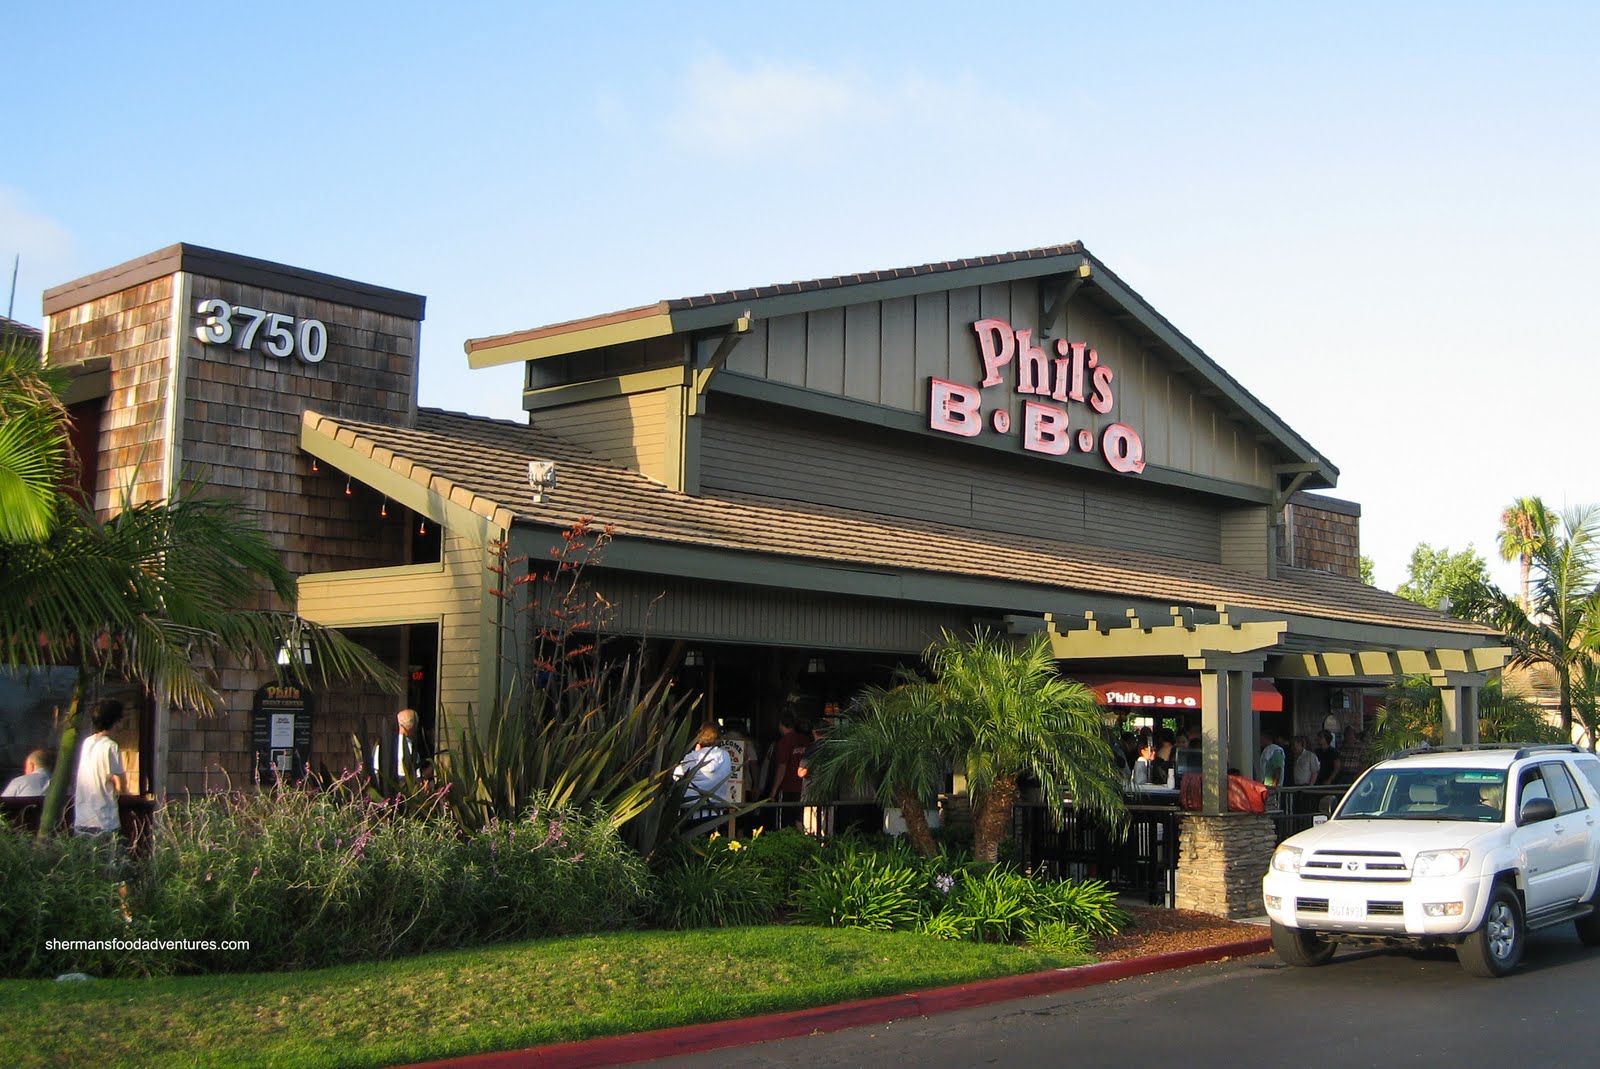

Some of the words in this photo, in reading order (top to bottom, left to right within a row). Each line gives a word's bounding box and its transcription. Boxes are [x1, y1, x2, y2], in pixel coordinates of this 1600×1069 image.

[195, 299, 328, 363] 3750
[973, 318, 1113, 414] Phil's
[267, 686, 301, 699] Phil's
[1105, 691, 1141, 704] Phil's
